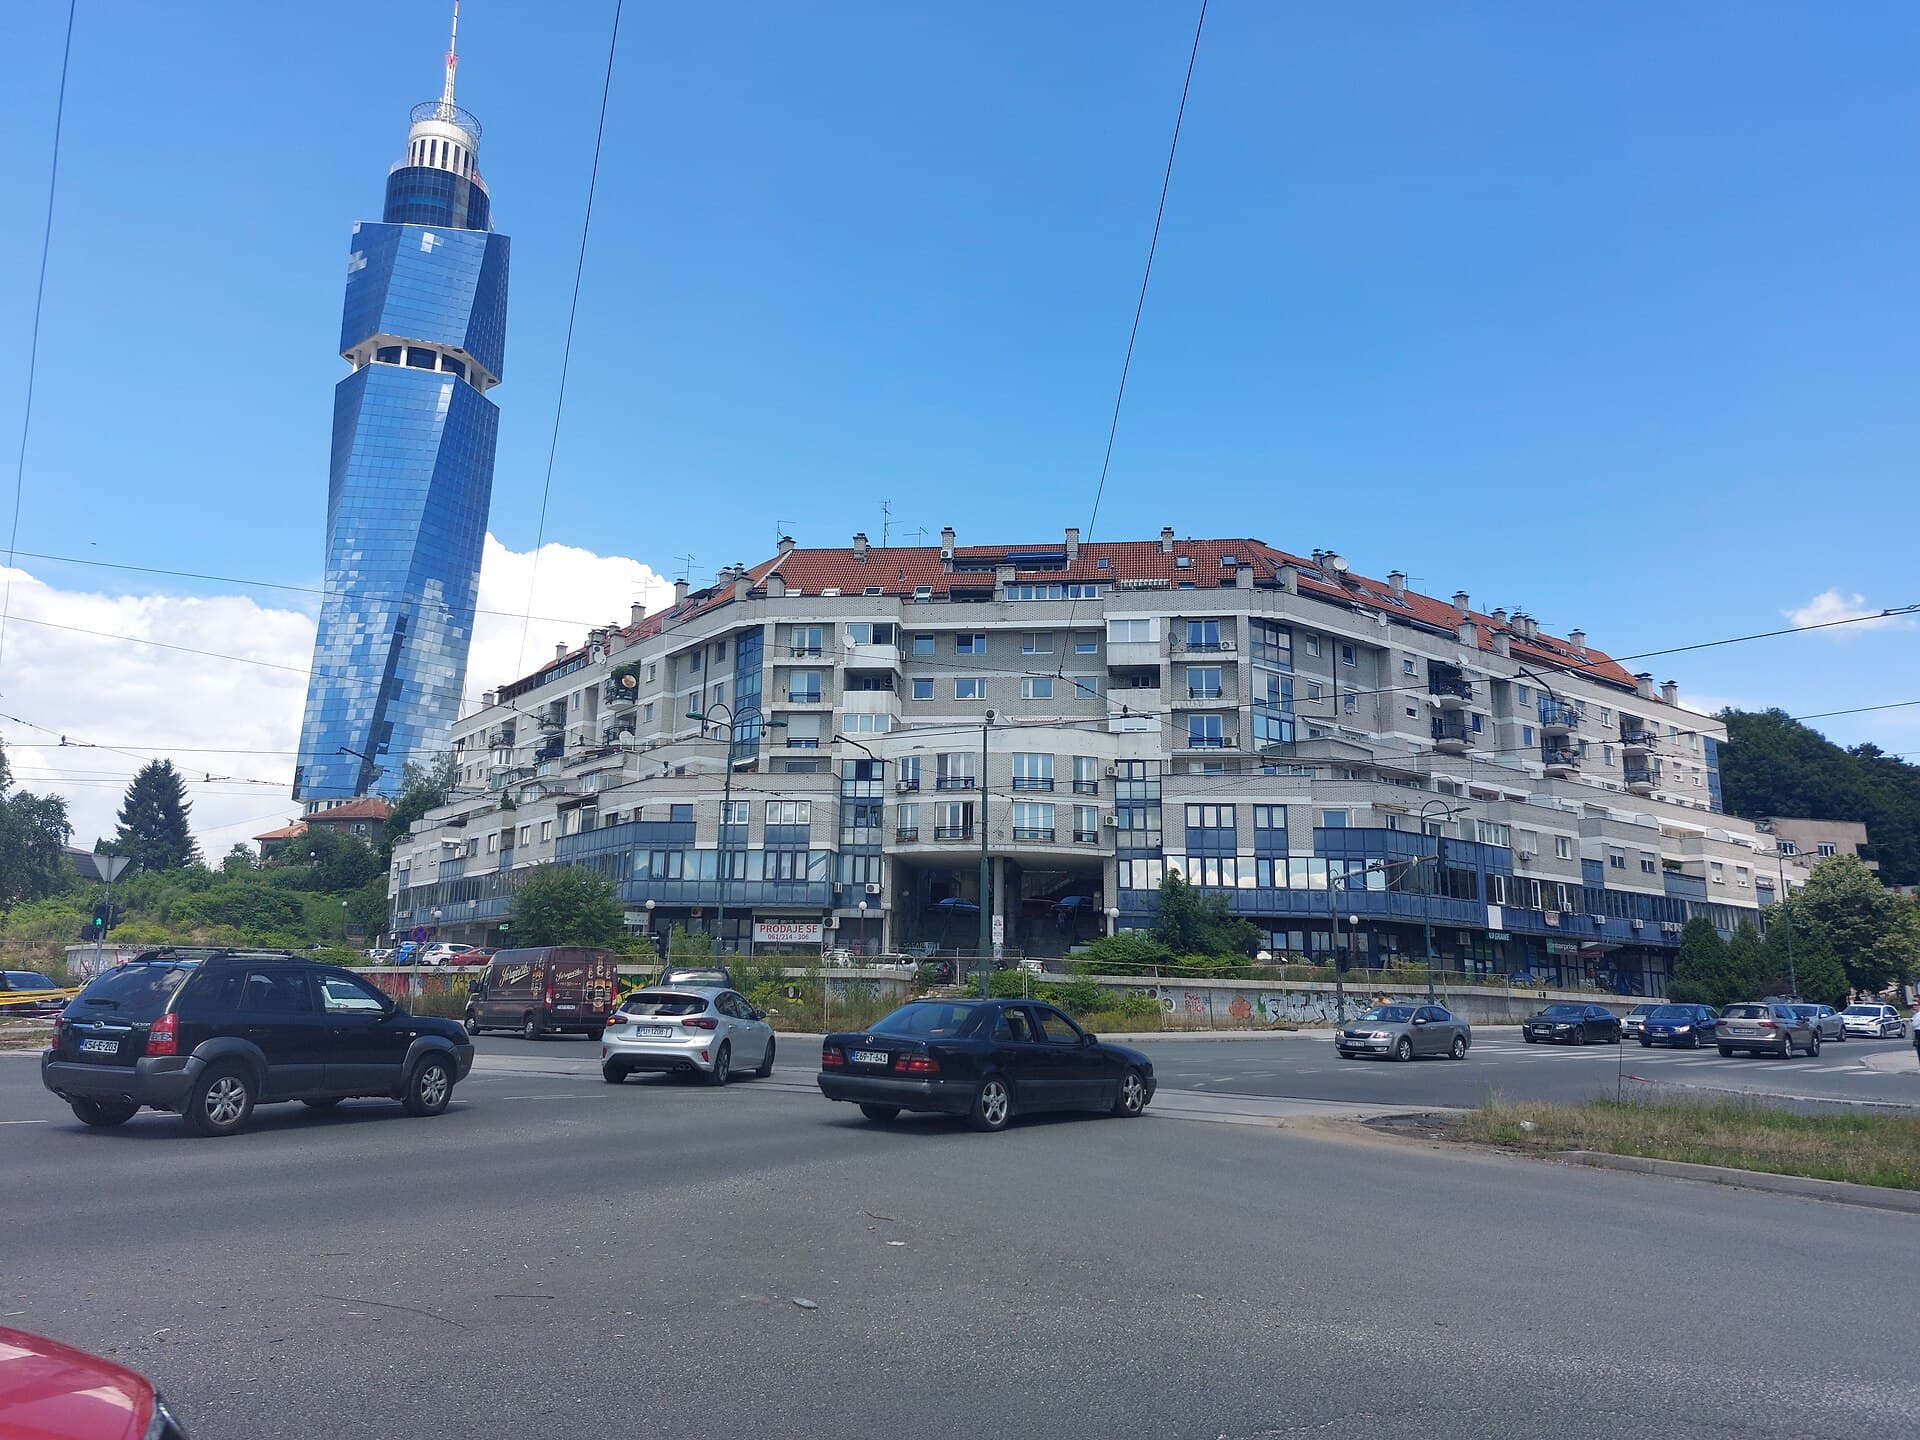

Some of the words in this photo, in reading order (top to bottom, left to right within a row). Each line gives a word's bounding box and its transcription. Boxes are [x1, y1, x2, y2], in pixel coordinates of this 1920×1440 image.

[760, 924, 804, 934] PRODAJE
[806, 924, 818, 934] SE
[83, 1039, 118, 1053] K54-E-203
